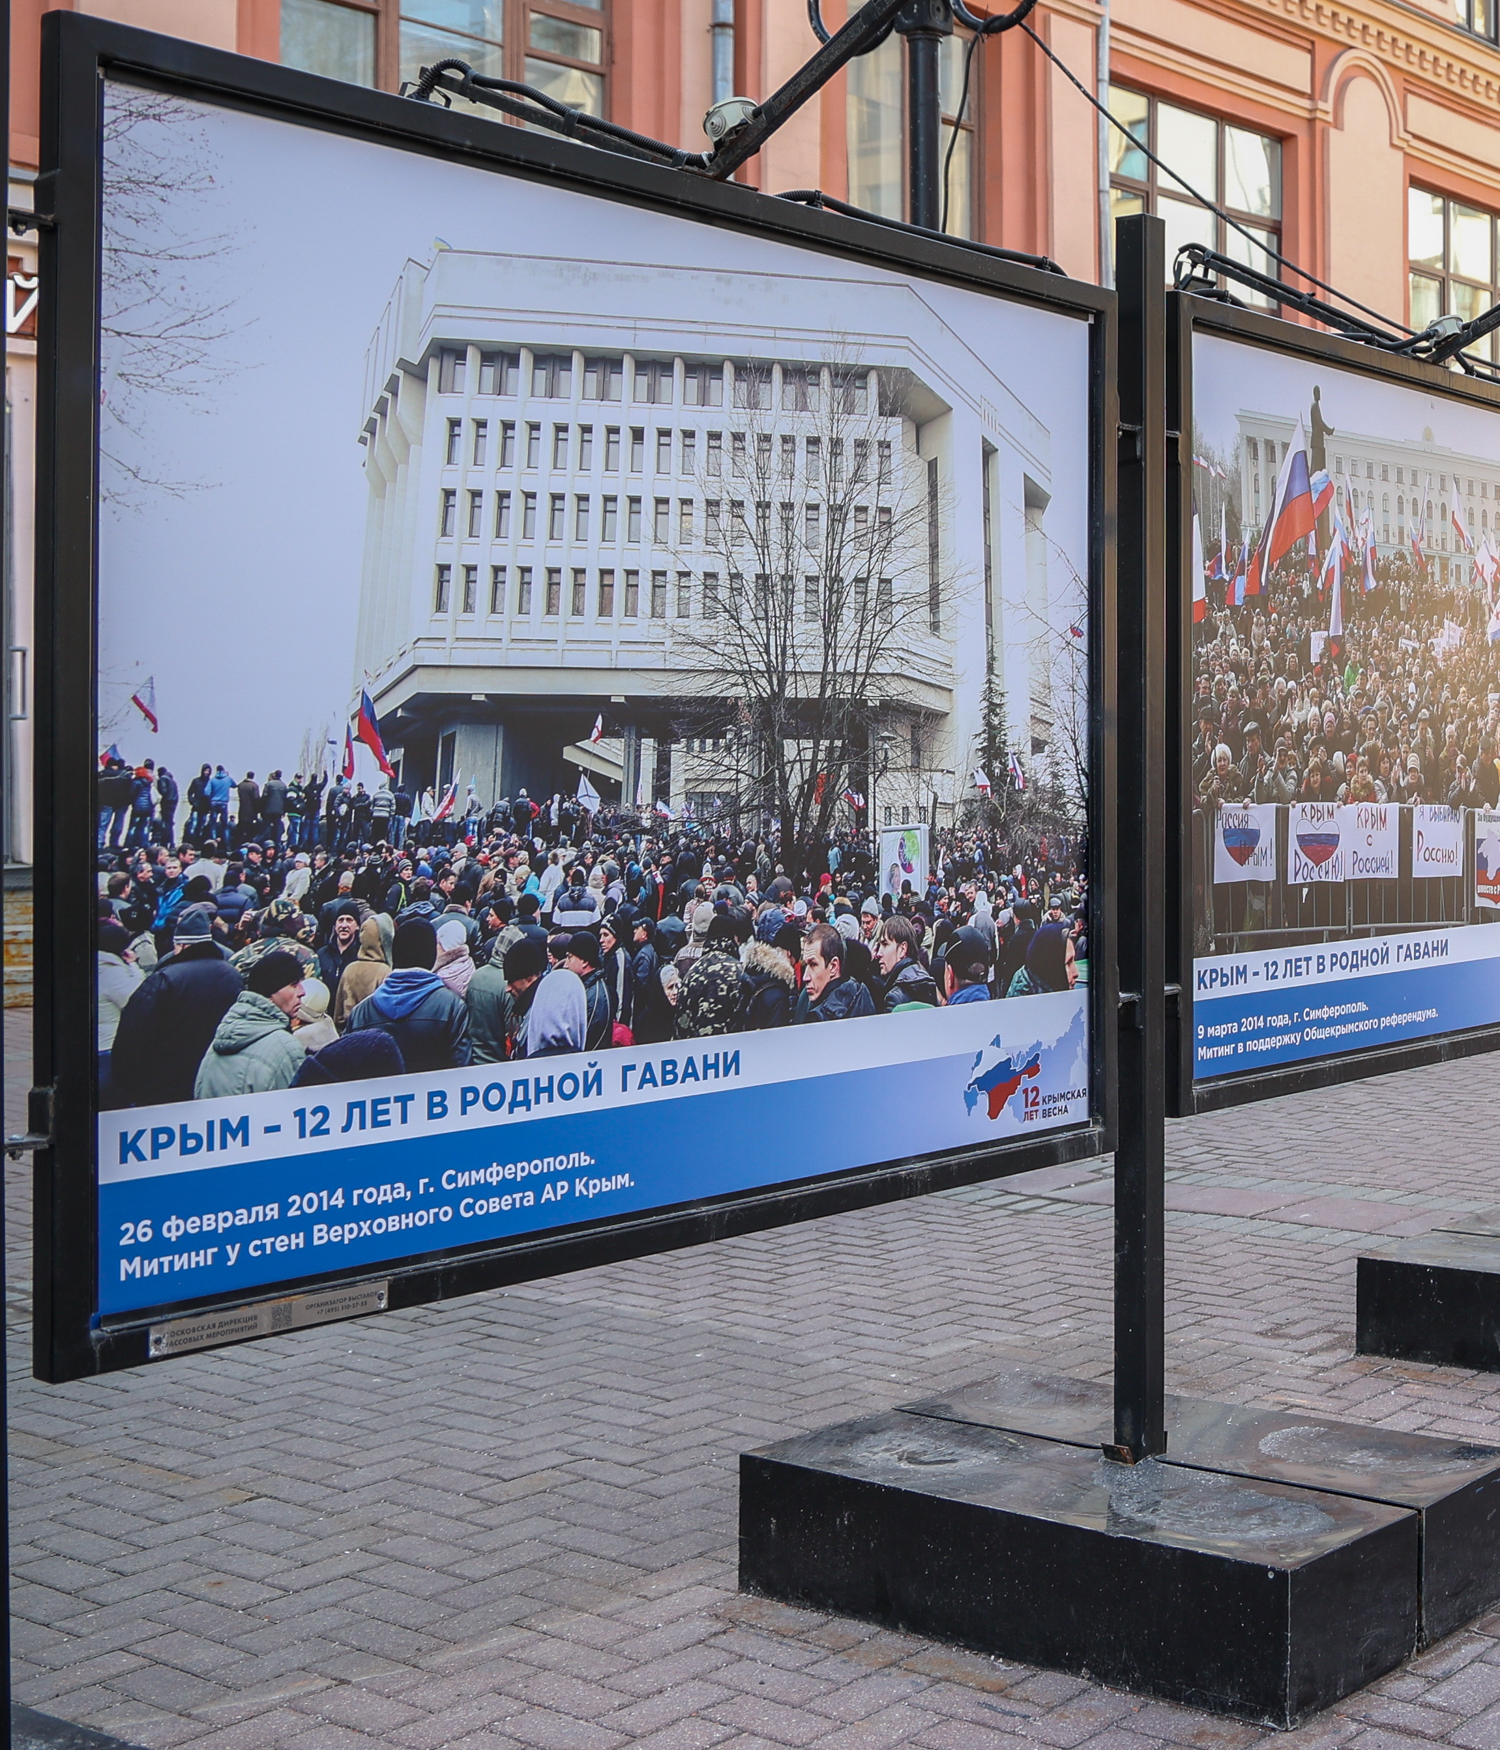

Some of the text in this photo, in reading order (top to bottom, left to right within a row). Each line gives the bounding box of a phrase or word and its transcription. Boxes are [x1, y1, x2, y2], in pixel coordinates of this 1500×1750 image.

[1301, 804, 1335, 823] КРЫМ
[1357, 807, 1387, 831] КРЫМ
[1197, 964, 1247, 991] КРЫМ
[1264, 960, 1278, 983] 12
[1282, 954, 1313, 980] ЛЕТ
[1317, 953, 1326, 974] В
[1330, 941, 1389, 973] РОДНОЙ
[1396, 939, 1449, 963] ГАВАНИ
[1197, 1001, 1369, 1043] 9 марта 2014 года, г. Симферополь.
[1197, 1007, 1439, 1061] Митинг в поддержку Общекрымского референдума.
[118, 1114, 250, 1165] КРЫМ
[293, 1105, 331, 1139] 12
[341, 1093, 416, 1134] ЛЕТ
[426, 1090, 448, 1121] В
[460, 1061, 603, 1115] РОДНОЙ
[621, 1049, 741, 1092] ГАВАНИ
[1022, 1086, 1040, 1109] 12
[1041, 1088, 1087, 1106] КРЫМСКАЯ
[1023, 1104, 1069, 1122] ЛЕТ ВЕСНА
[119, 1151, 597, 1246] 26 февраля 2014 года, г. Симферополь.
[119, 1172, 636, 1282] Митинг у стен Верховного Совета АР Крым.
[305, 1297, 347, 1310] ОРГАНИЗАТОР
[206, 1321, 258, 1340] МЕРОПРИЯТИЙ
[218, 1314, 258, 1330] ДИРЕКЦИЯ
